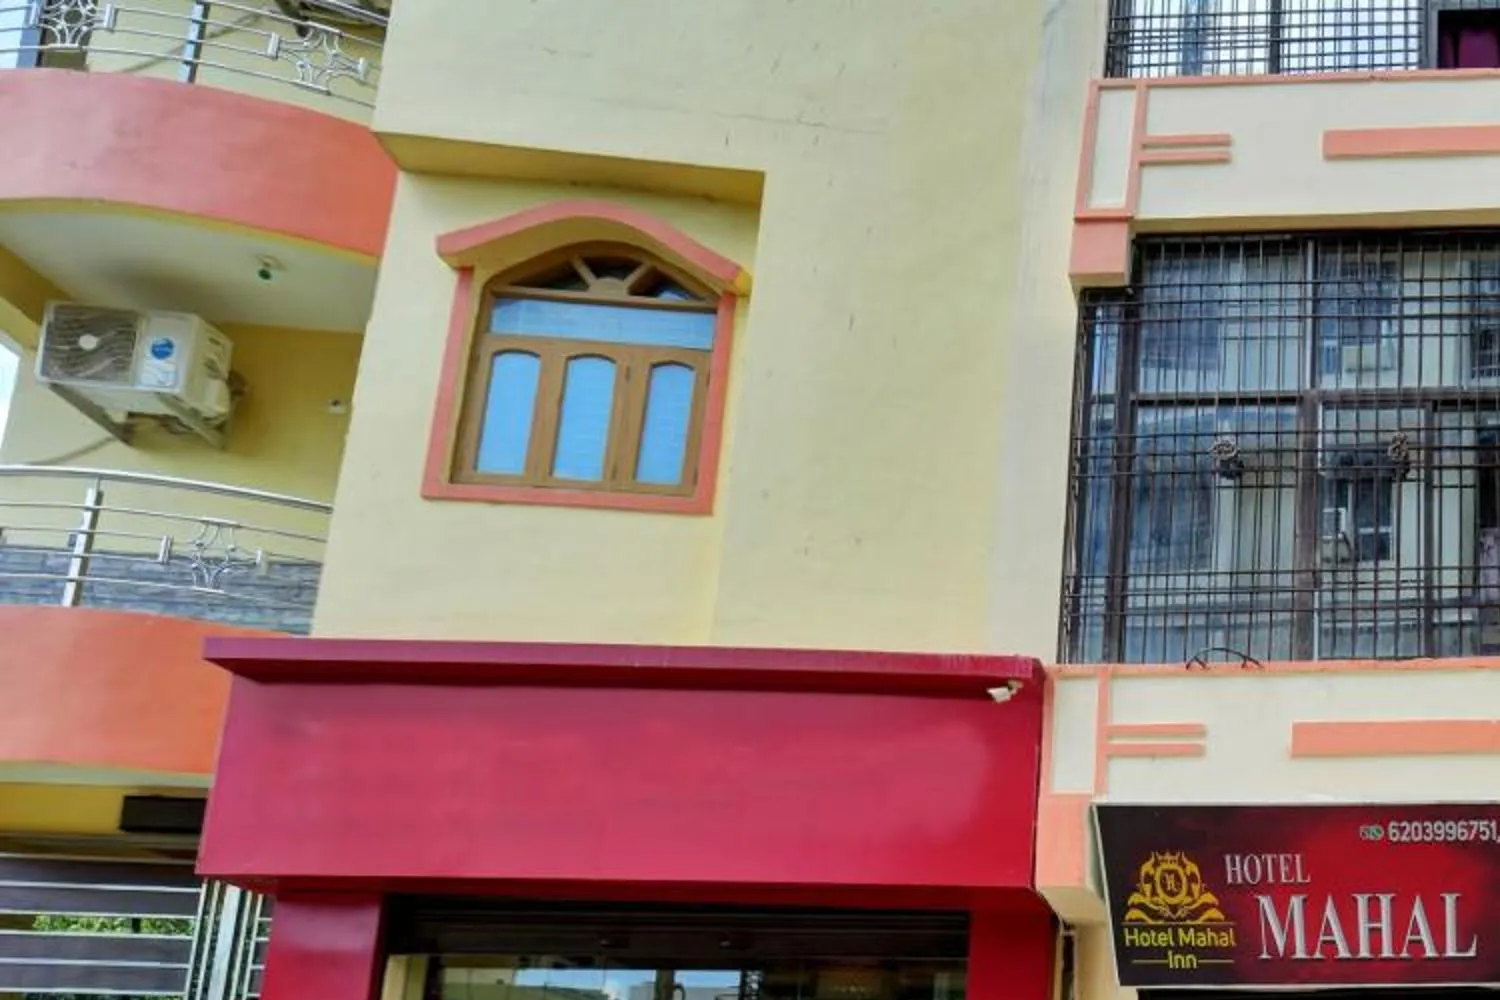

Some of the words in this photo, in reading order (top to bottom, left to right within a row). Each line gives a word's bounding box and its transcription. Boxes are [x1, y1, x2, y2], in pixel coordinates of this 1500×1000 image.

[1224, 852, 1311, 886] HOTEL
[1123, 927, 1175, 947] Hotel
[1177, 927, 1236, 947] Mahal
[1256, 892, 1478, 961] MAHAL
[1167, 949, 1198, 968] Inn
